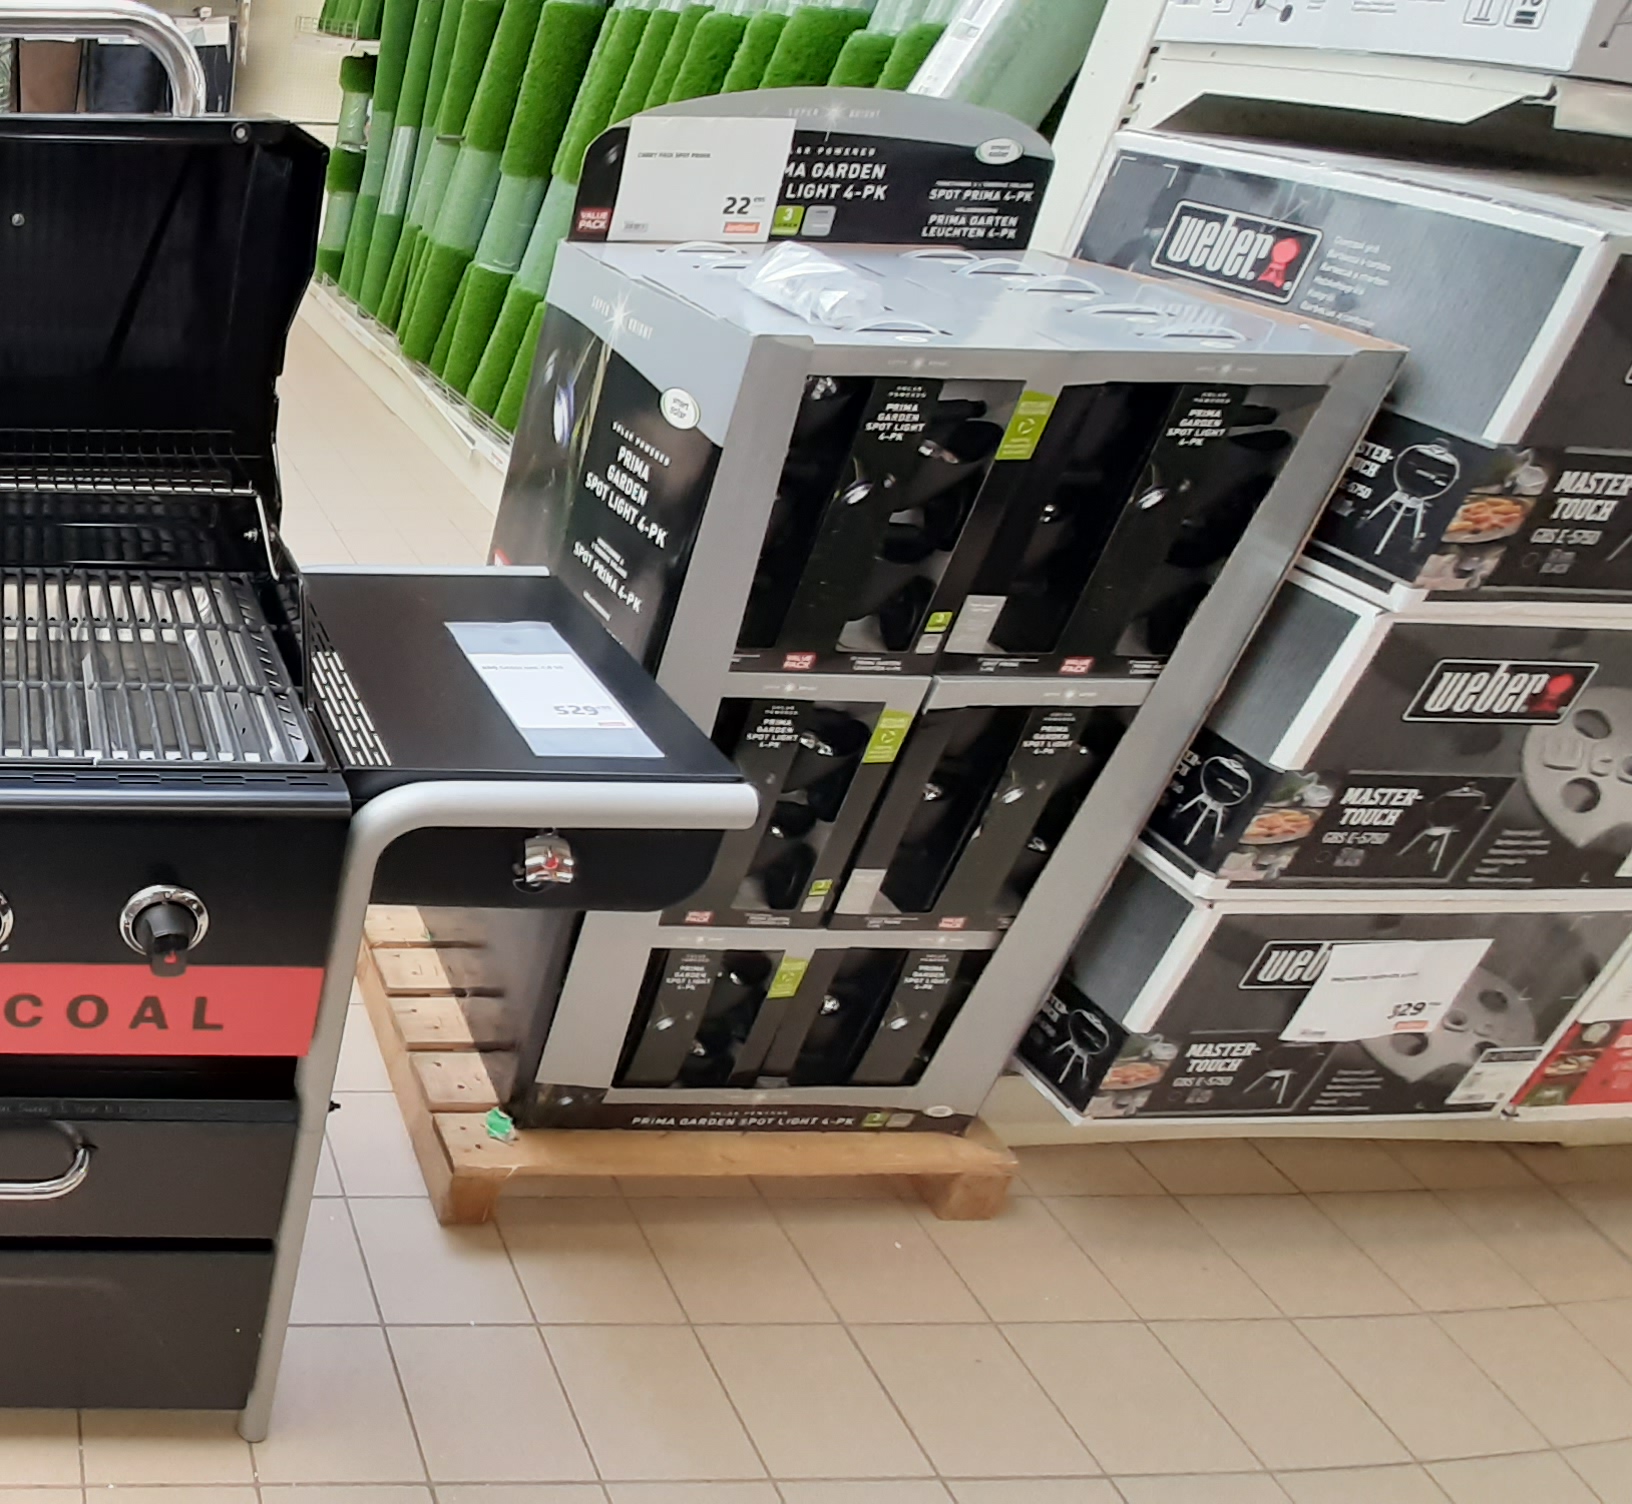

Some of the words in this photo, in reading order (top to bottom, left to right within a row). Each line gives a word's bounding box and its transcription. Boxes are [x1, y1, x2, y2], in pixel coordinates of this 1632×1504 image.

[816, 146, 877, 158] POWERED
[811, 162, 887, 181] GARDEN
[785, 183, 840, 200] LIGHT
[842, 183, 889, 201] 4-PK
[928, 188, 960, 200] SPOT
[961, 190, 1002, 202] PRIMA
[1002, 190, 1035, 203] 4-PK
[722, 196, 751, 215] 22
[580, 210, 609, 220] VALUE
[782, 208, 793, 221] 3
[927, 213, 967, 226] PRIMA
[968, 214, 1020, 228] GARTEN
[577, 219, 608, 231] PACK
[920, 225, 985, 238] LEUCHTEN
[986, 227, 1019, 239] 4-PK
[1165, 214, 1276, 282] weber
[884, 402, 919, 412] PRIMA
[1188, 408, 1223, 418] PRIMA
[876, 412, 921, 422] GARDEN
[1178, 418, 1224, 428] GARDEN
[865, 422, 892, 432] SPOT
[893, 422, 927, 433] LIGHT
[1165, 427, 1195, 437] SPOT
[1193, 427, 1227, 438] LIGHT
[877, 432, 905, 442] 4-PK
[1177, 437, 1205, 447] 4-PK
[611, 420, 635, 443] SOLAR
[634, 435, 672, 468] POWERED
[1356, 440, 1396, 464] STER-
[616, 445, 651, 483] PRIMA
[606, 463, 649, 507] GARDEN
[583, 470, 610, 503] SPOT
[608, 493, 640, 527] LIGHT
[636, 516, 669, 550] 4-PK
[1550, 497, 1620, 522] TOUCH
[572, 540, 594, 569] SPOT
[591, 561, 618, 594] PRIMA
[616, 585, 644, 614] 4-PK
[1422, 670, 1552, 714] weber
[552, 704, 600, 717] 529
[762, 718, 793, 727] PRIMA
[756, 725, 795, 734] GARDEN
[746, 733, 771, 742] SPOT
[770, 733, 800, 742] LIGHT
[1021, 740, 1046, 748] SPOT
[1046, 740, 1075, 748] LIGHT
[758, 740, 781, 749] 4-PK
[1339, 786, 1425, 807] MASTER-
[1338, 807, 1406, 828] TOUCH
[1256, 949, 1331, 983] web
[665, 977, 686, 985] SPOT
[903, 977, 925, 985] SPOT
[2, 992, 225, 1032] COAL
[1184, 1041, 1262, 1058] MASTER-
[1185, 1057, 1245, 1074] TOUCH
[631, 1116, 676, 1126] PRIMA
[679, 1116, 736, 1127] GARDEN
[738, 1116, 777, 1127] SPOT
[777, 1116, 820, 1127] LIGHT
[821, 1117, 855, 1127] 4-PK
